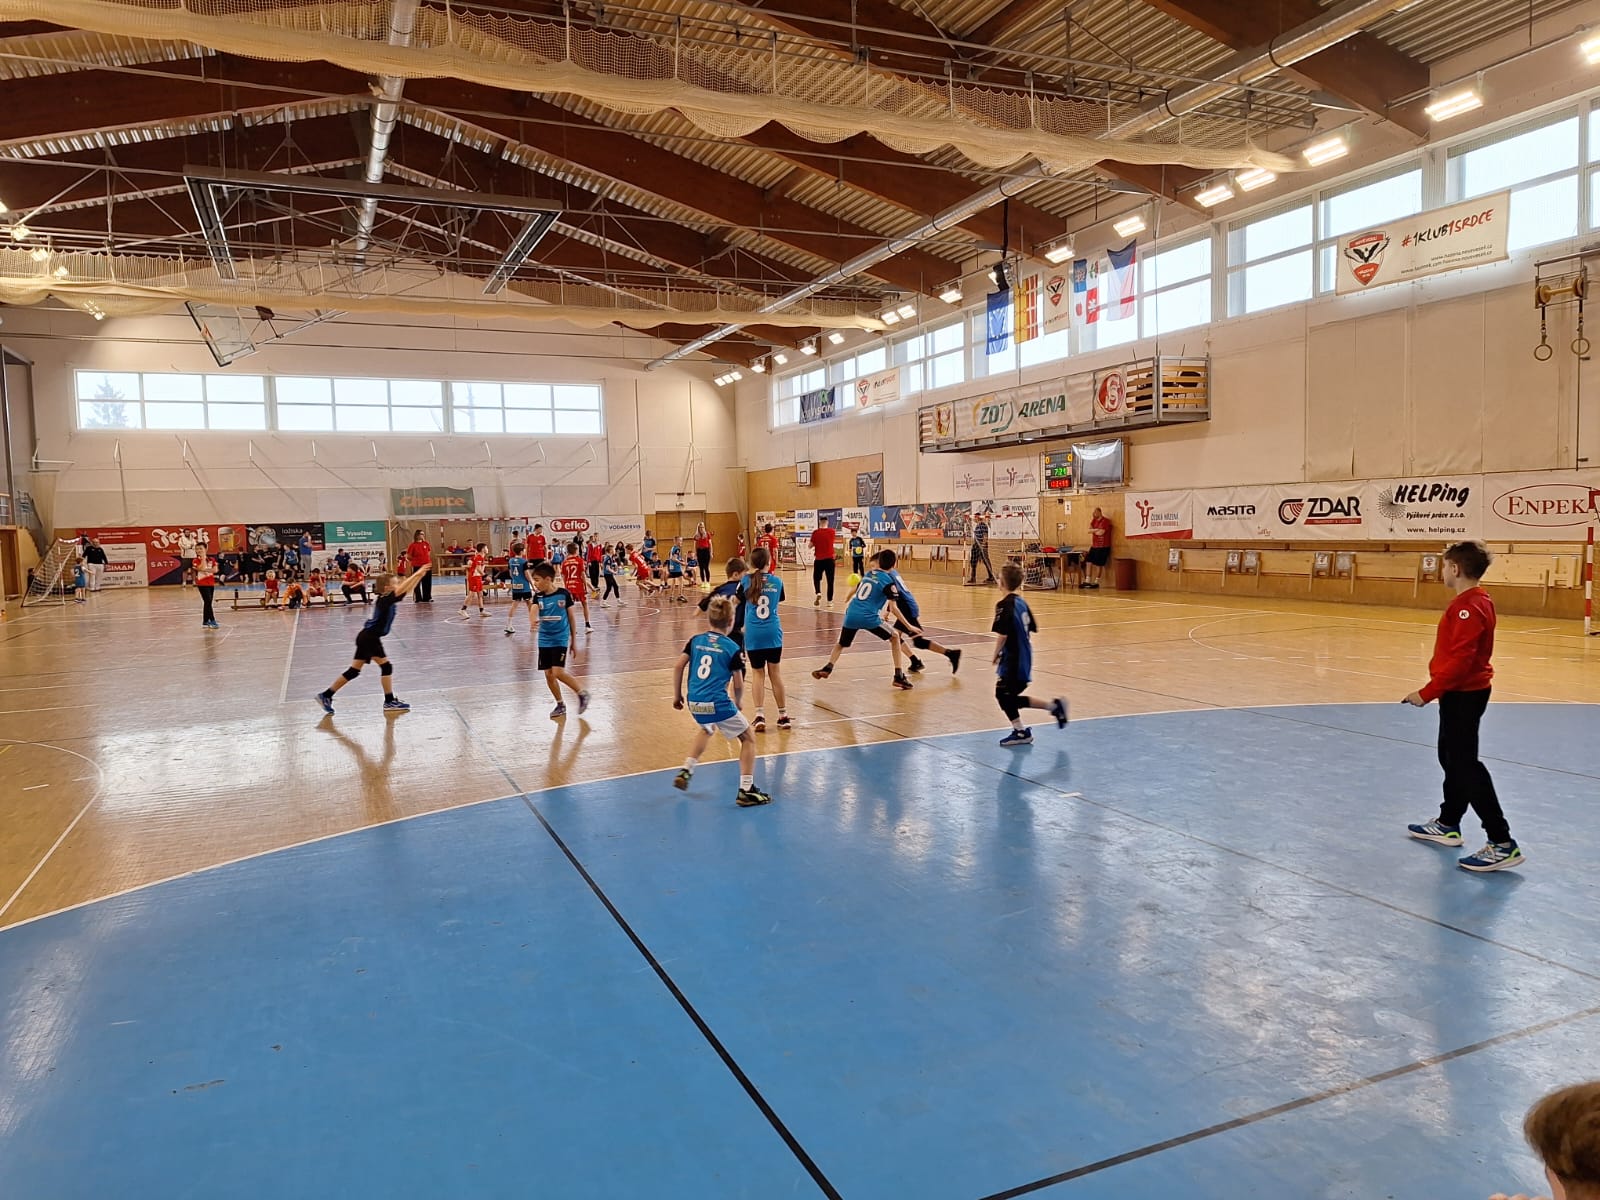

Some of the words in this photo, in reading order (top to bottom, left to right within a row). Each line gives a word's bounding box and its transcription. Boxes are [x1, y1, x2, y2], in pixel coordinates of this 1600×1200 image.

[1401, 209, 1494, 247] #1KLUB1SRDCE
[980, 402, 1007, 425] ZDT
[1018, 395, 1066, 418] ARENA
[1394, 482, 1470, 508] HELPing
[1508, 495, 1598, 516] ENPEK
[1307, 496, 1362, 518] ZDAR
[873, 521, 897, 532] ALPA
[512, 566, 520, 576] 4
[566, 565, 578, 579] 12
[756, 595, 770, 619] 8
[697, 654, 713, 680] 8
